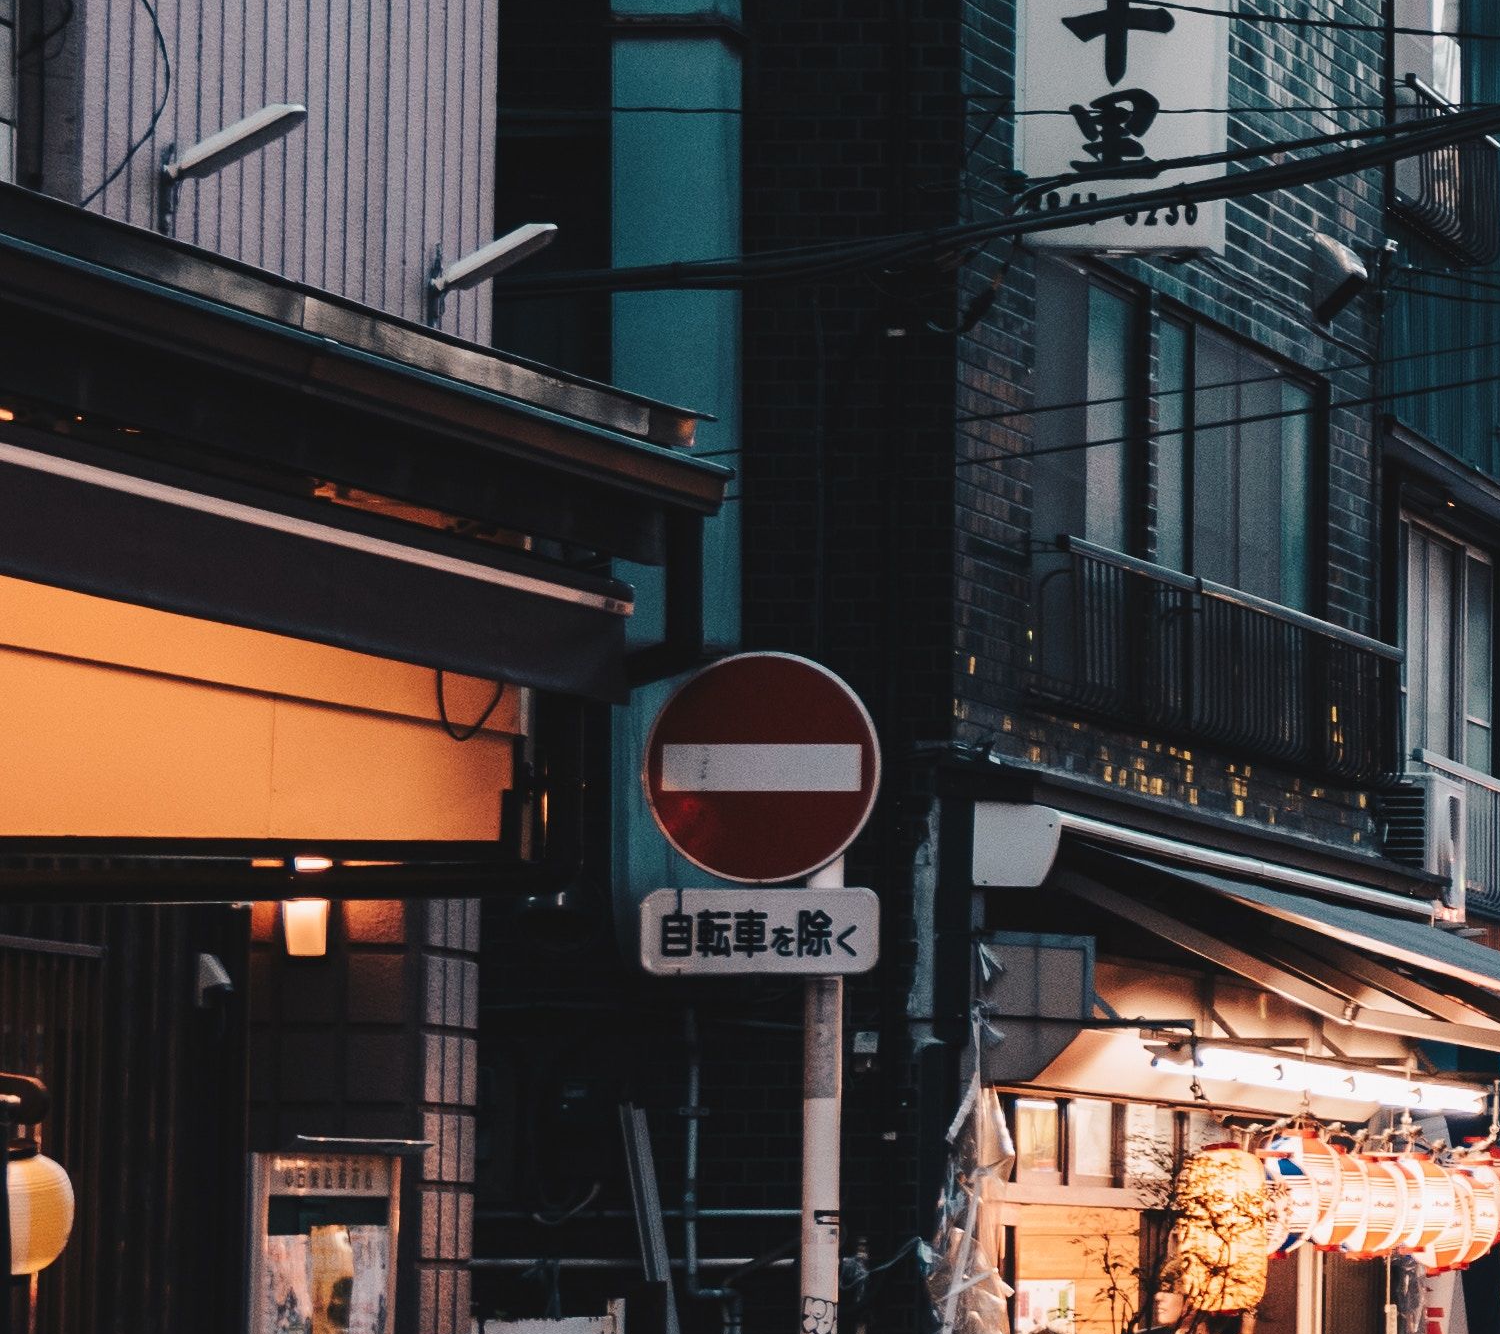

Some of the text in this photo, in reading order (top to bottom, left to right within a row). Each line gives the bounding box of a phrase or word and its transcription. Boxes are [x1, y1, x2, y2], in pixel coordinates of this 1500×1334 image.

[661, 909, 858, 958] 自転車を除く
